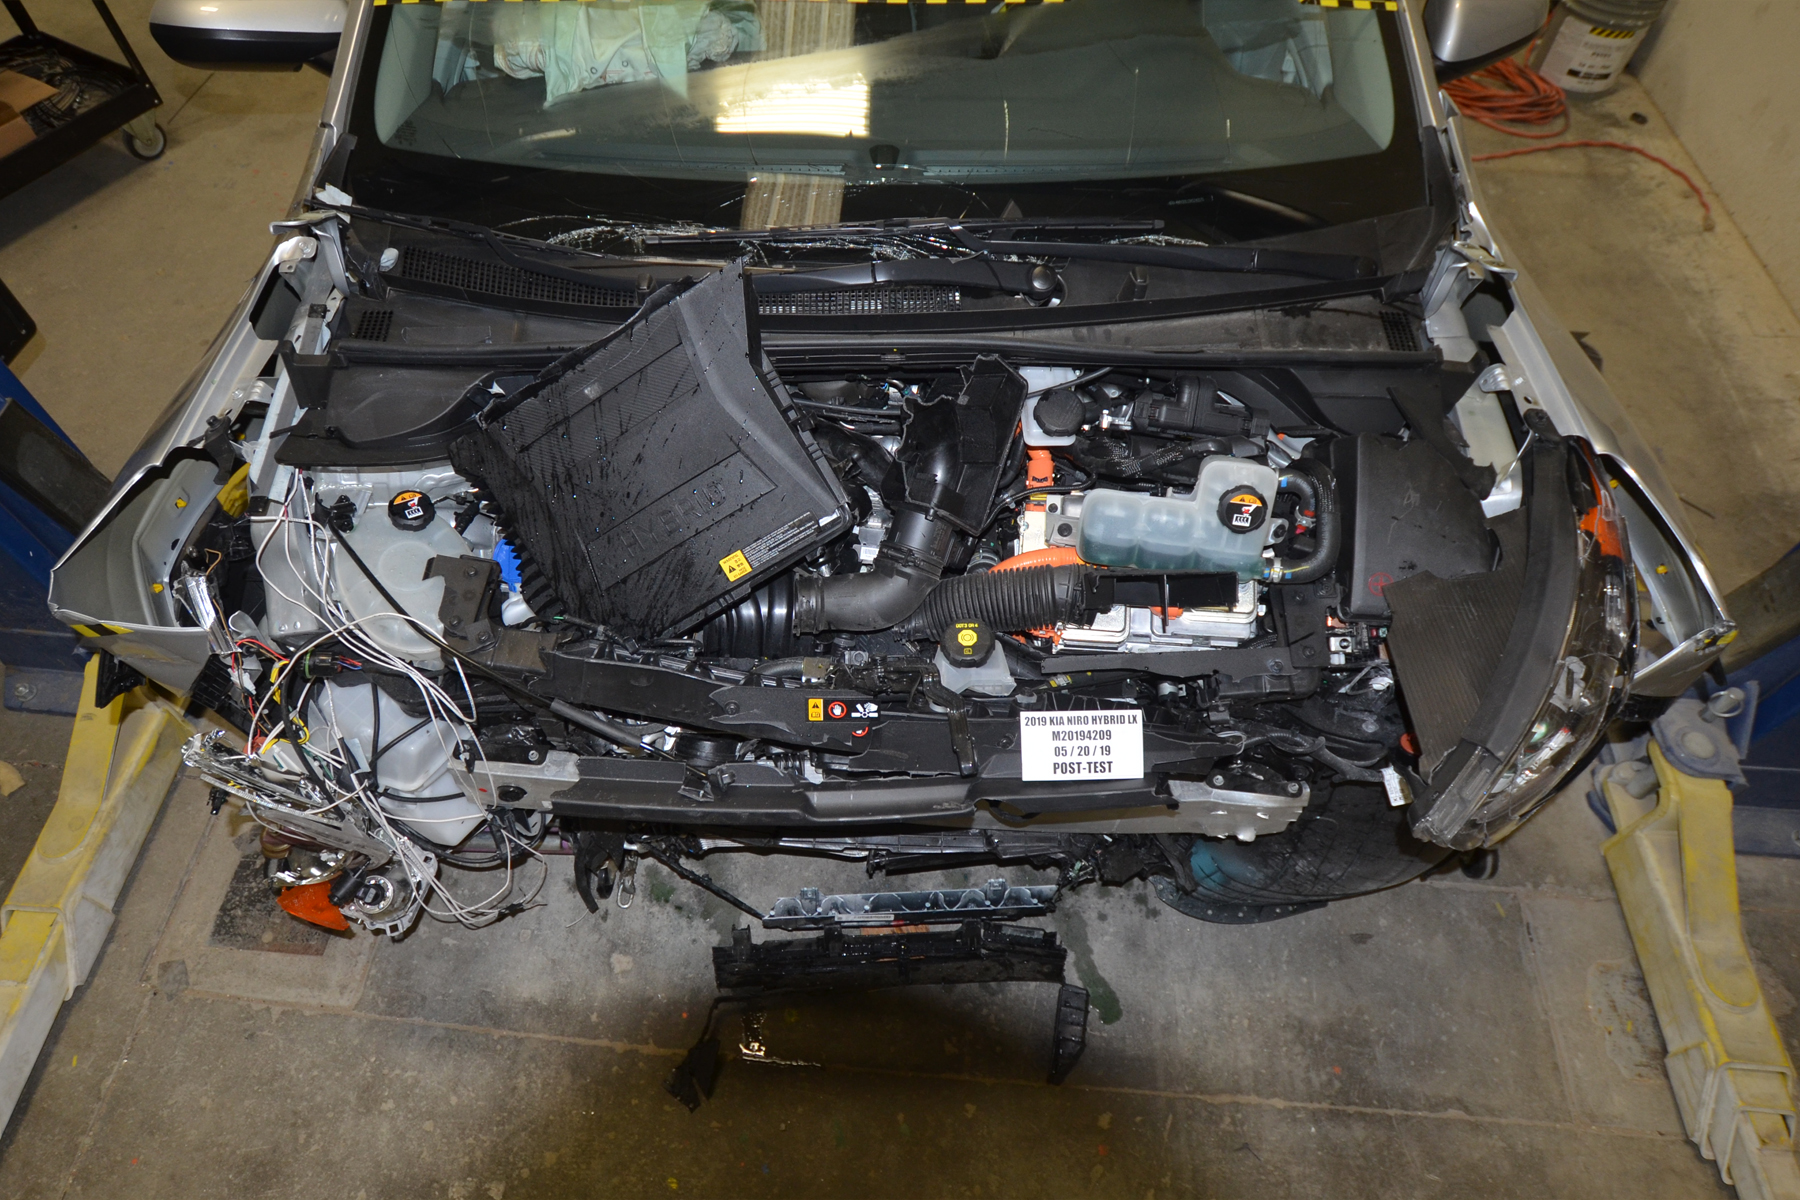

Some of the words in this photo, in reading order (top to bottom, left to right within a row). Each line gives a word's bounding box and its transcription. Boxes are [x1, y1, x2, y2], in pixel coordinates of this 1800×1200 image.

[620, 480, 726, 557] HYBRID
[1024, 716, 1047, 727] 2019
[1049, 716, 1065, 726] KIA
[1067, 715, 1089, 726] NIRO
[1091, 714, 1126, 725] HYBRID
[1127, 714, 1138, 725] LX
[1052, 729, 1112, 742] M20194209
[1053, 761, 1113, 774] POST-TEST
